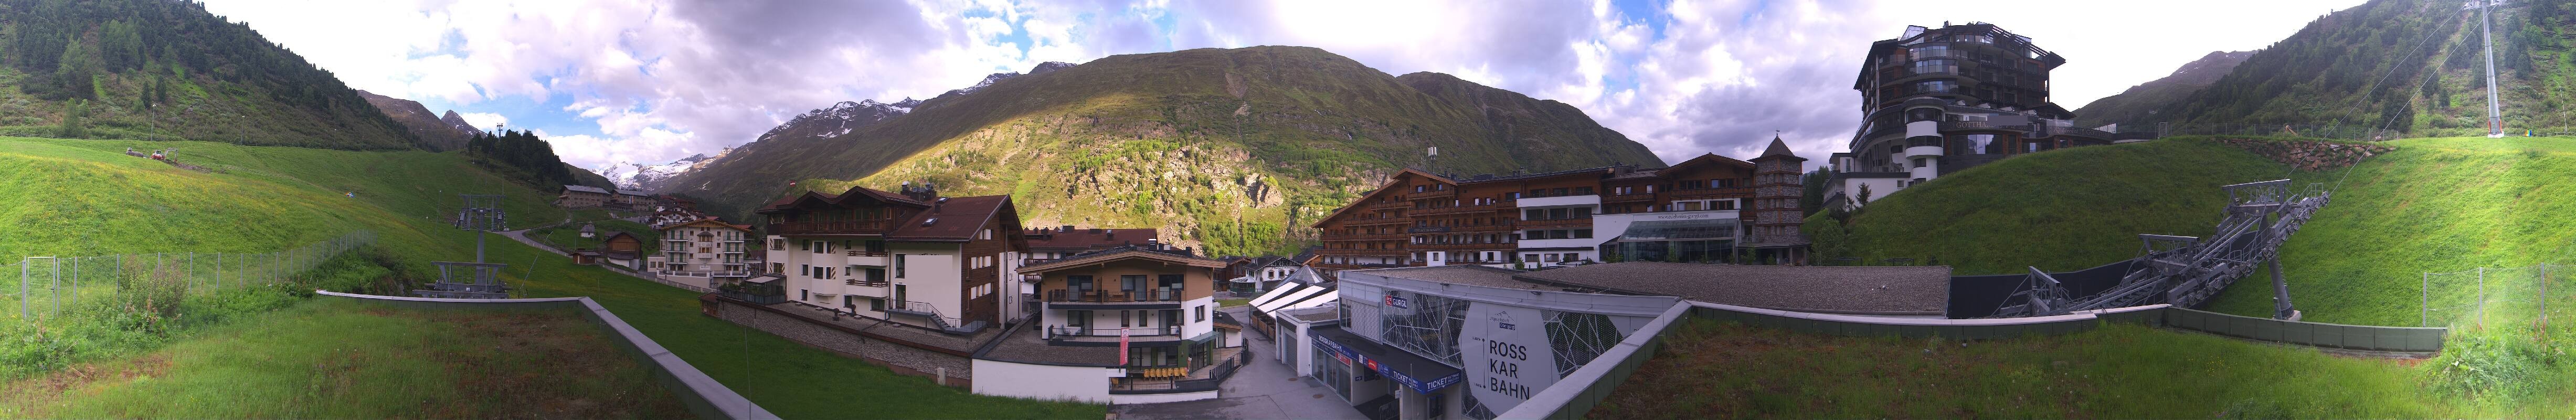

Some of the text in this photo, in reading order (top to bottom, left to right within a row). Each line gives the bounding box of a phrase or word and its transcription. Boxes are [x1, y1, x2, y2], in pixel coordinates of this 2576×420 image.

[1393, 299, 1407, 308] GURGL
[1319, 335, 1342, 352] ROSSKARBAHN
[1490, 340, 1526, 361] ROSS
[1393, 371, 1408, 383] TICKET
[1490, 358, 1518, 379] KAR
[1427, 377, 1447, 390] TICKET
[1491, 377, 1530, 400] BAHN
